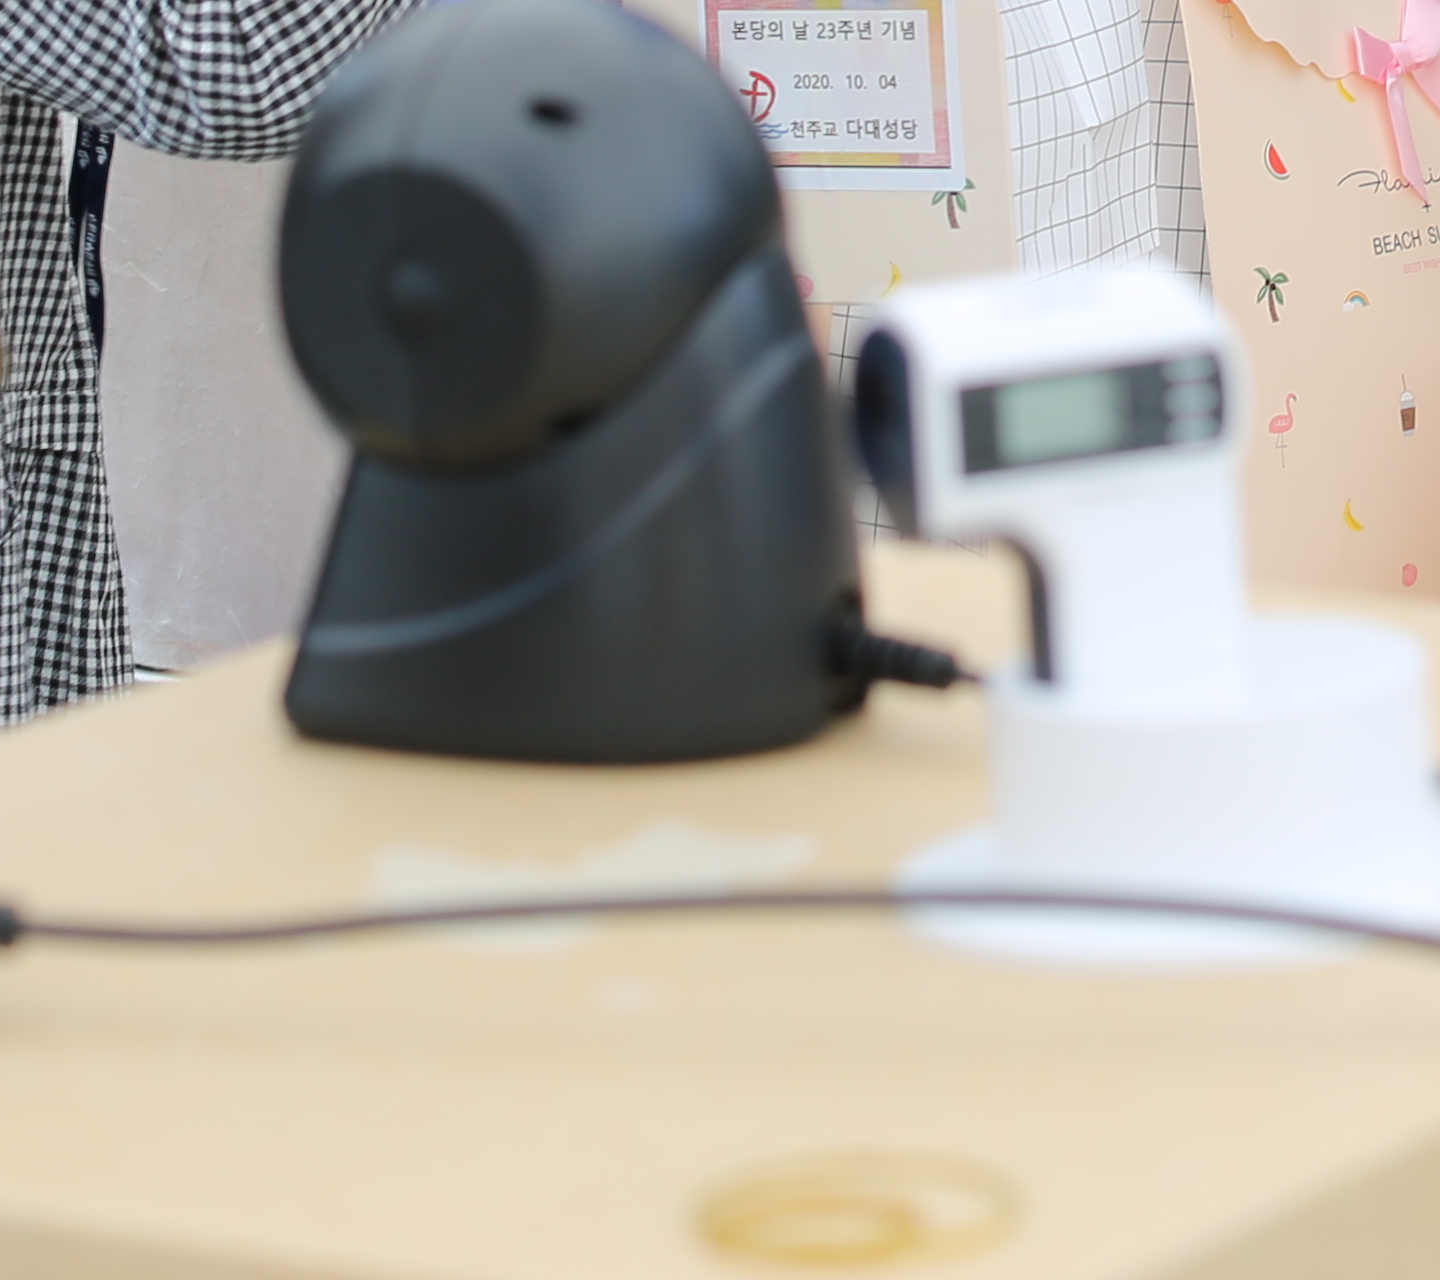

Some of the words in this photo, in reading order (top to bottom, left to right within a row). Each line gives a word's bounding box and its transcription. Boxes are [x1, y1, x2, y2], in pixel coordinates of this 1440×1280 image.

[731, 20, 784, 40] 본당의
[792, 20, 809, 40] 날
[816, 20, 872, 40] 23주년
[881, 20, 916, 40] 기념
[793, 74, 834, 90] 2020.
[846, 74, 868, 90] 10.
[878, 74, 898, 90] 04
[790, 120, 839, 139] 천주교
[846, 119, 918, 140] 다대성당
[1372, 229, 1423, 256] BEACH
